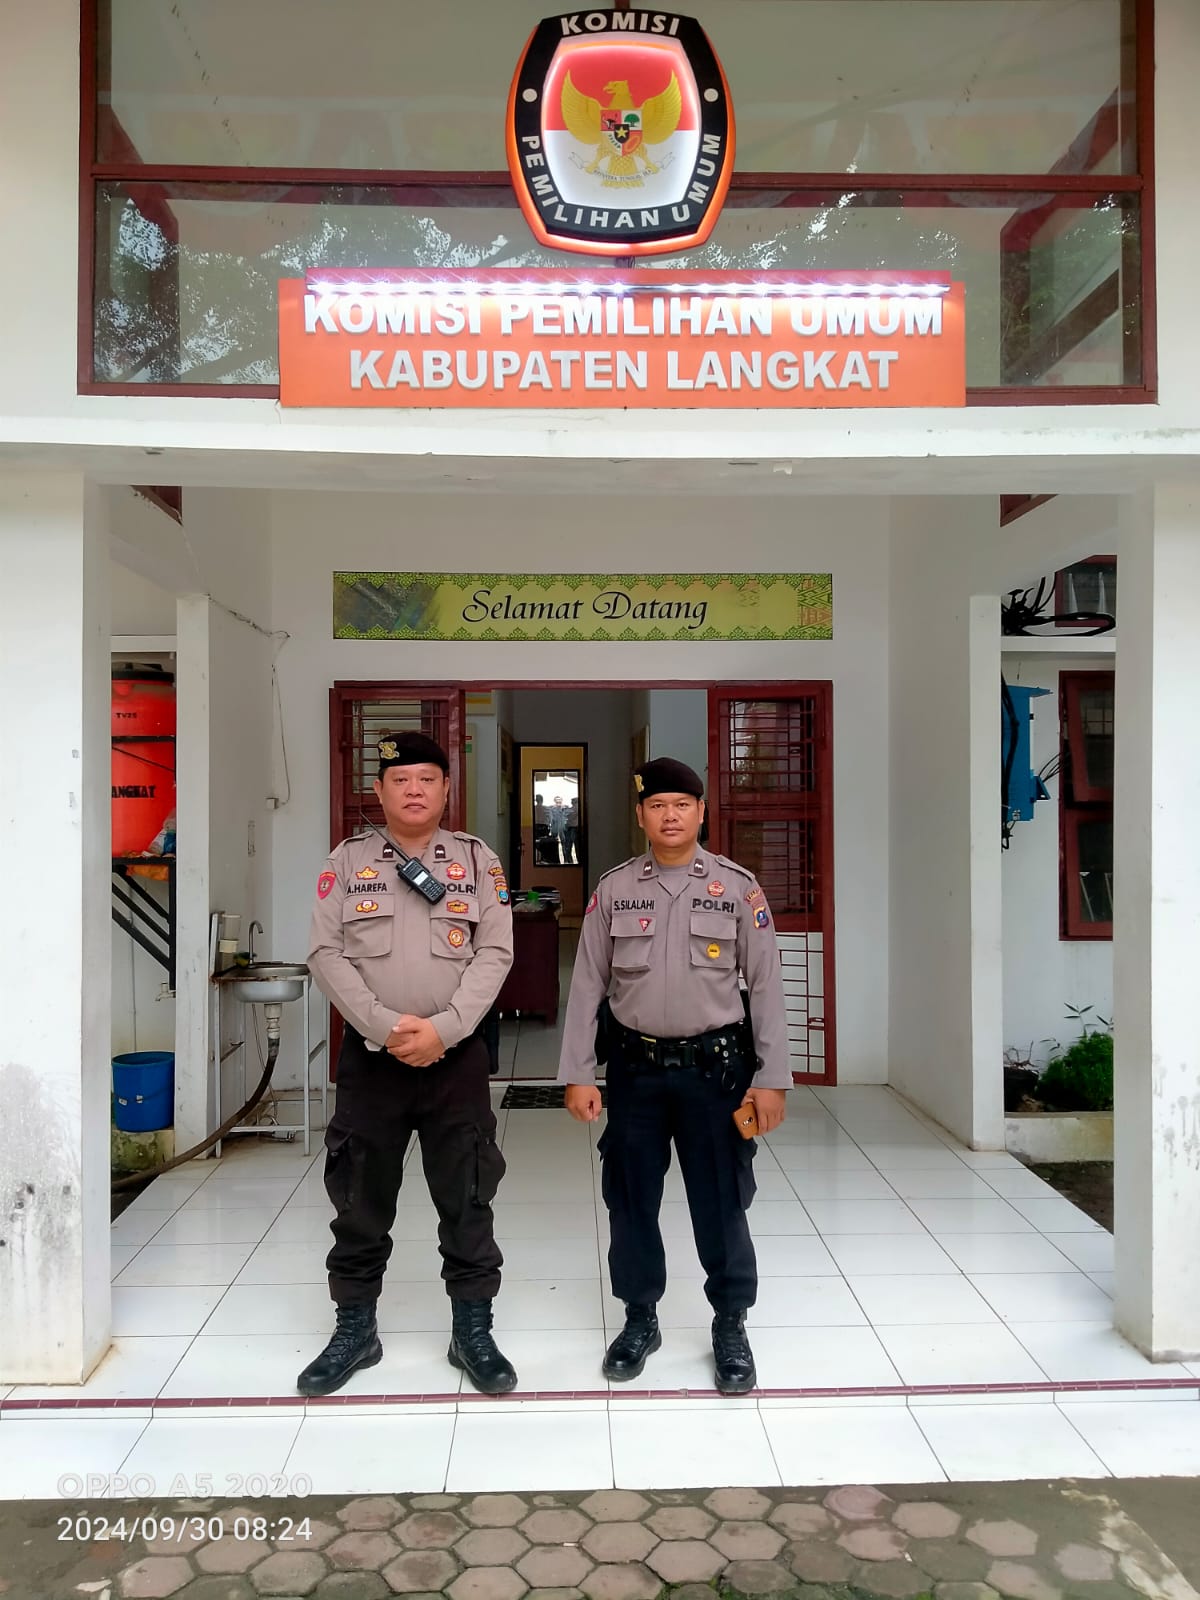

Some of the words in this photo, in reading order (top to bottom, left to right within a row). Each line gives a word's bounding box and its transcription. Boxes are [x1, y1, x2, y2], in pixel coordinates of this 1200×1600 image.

[560, 11, 680, 36] KOMISI
[521, 135, 660, 228] PEMILIHAN
[671, 133, 722, 223] UMUM
[303, 294, 481, 335] KOMISI
[500, 296, 773, 336] PEMILIHAN
[789, 296, 943, 336] UMUM
[350, 350, 648, 390] KABUPATEN
[667, 350, 899, 390] LANGKAT
[462, 590, 585, 623] Selamat
[592, 591, 708, 630] Datang
[346, 882, 388, 895] A.HAREFA
[692, 898, 735, 914] POLRI
